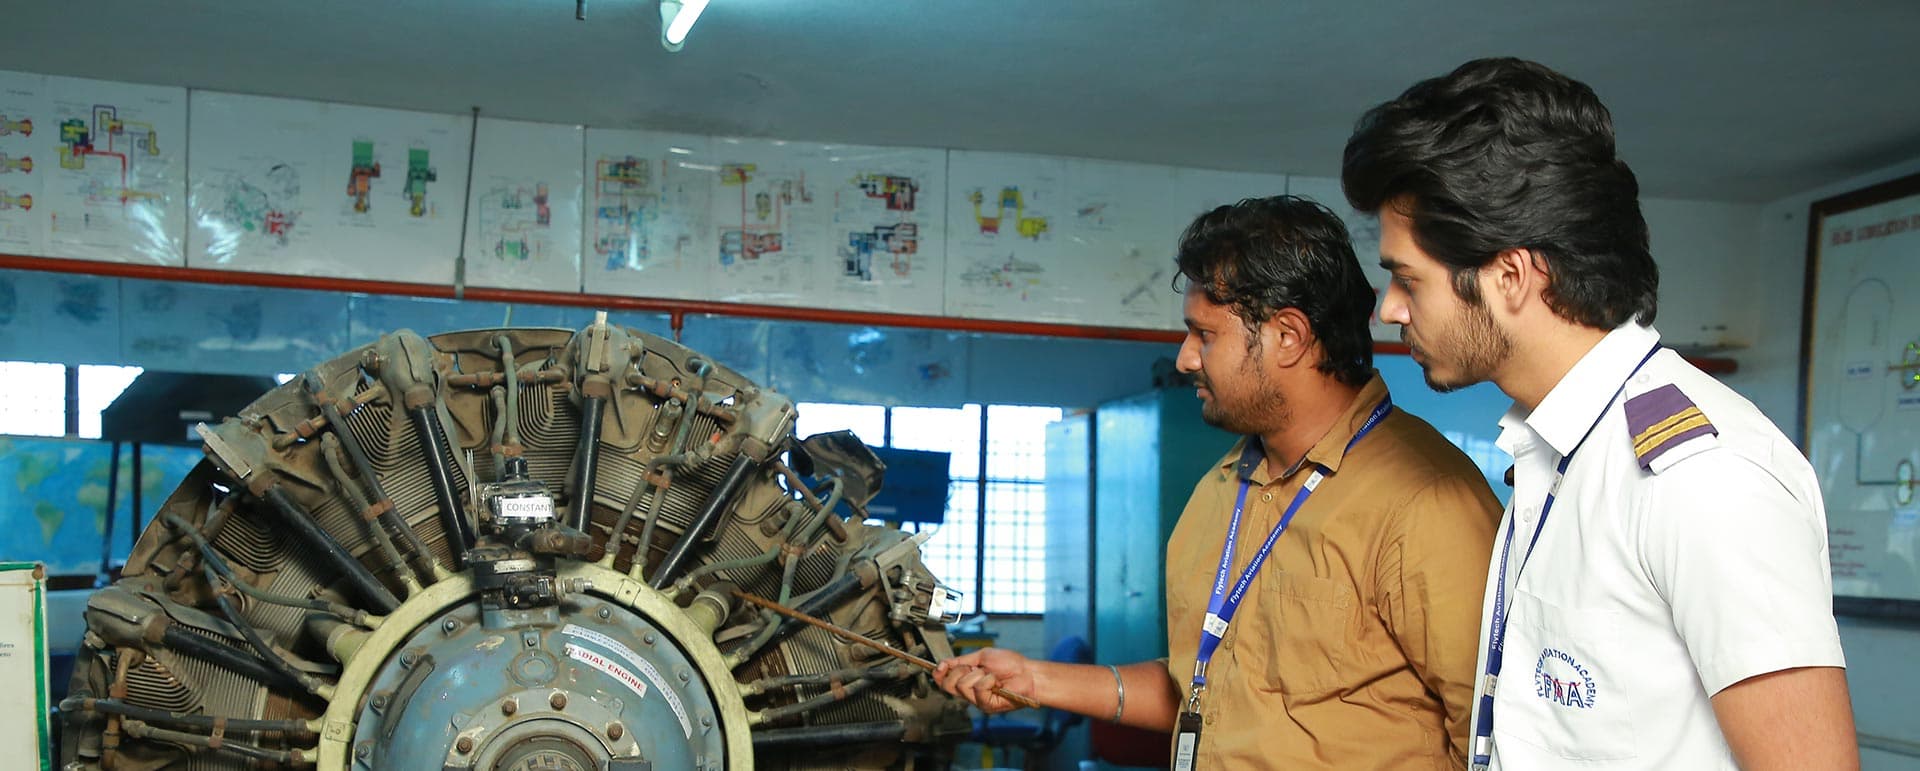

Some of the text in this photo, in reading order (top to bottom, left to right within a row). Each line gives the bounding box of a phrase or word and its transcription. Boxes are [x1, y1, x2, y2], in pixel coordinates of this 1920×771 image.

[506, 503, 551, 512] CONSTANT
[1215, 569, 1227, 595] Flytech
[1222, 540, 1233, 569] Aviation
[1230, 524, 1283, 604] Flytech Aviation Academy
[1491, 617, 1501, 649] Flytech
[607, 664, 643, 692] ENGINE
